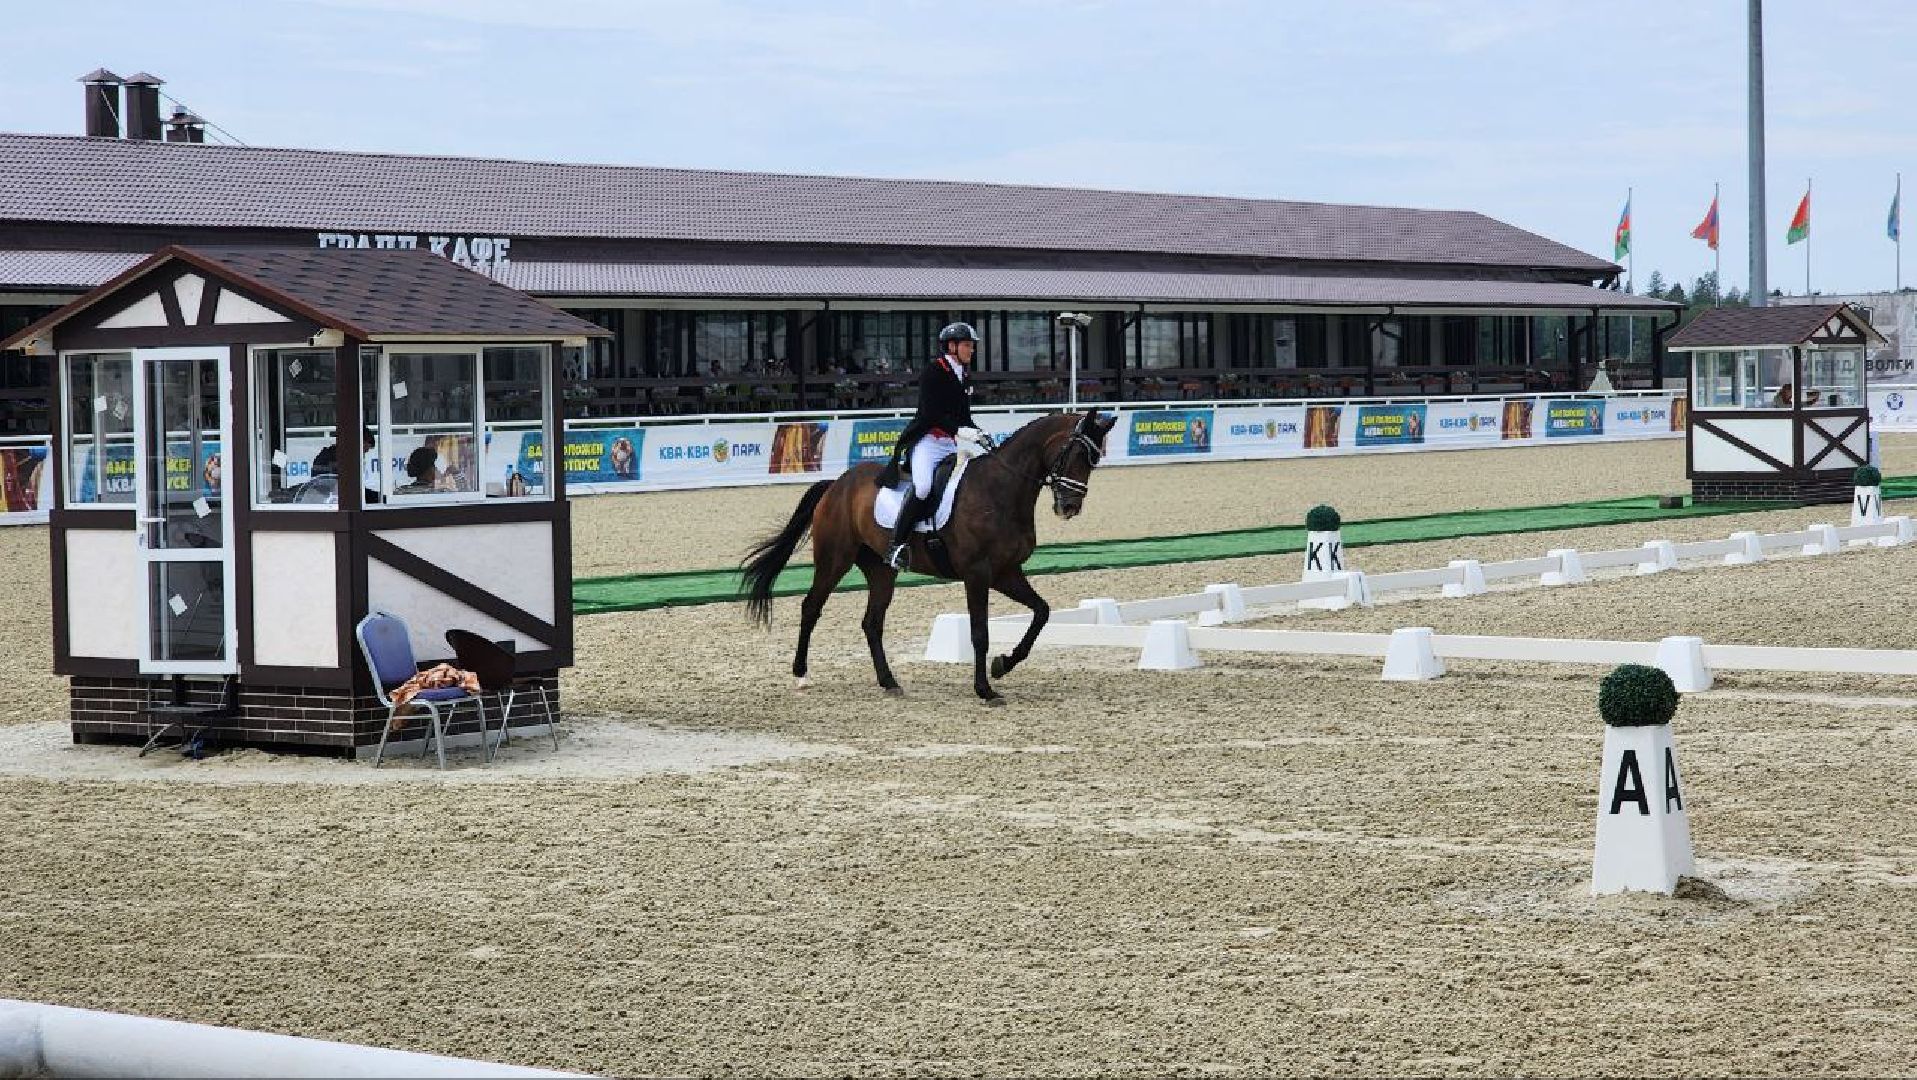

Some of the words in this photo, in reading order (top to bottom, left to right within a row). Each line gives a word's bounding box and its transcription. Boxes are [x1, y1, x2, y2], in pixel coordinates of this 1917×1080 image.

[429, 236, 511, 265] КАФЕ
[732, 443, 761, 457] ПАРК
[1857, 494, 1871, 516] V
[1308, 542, 1323, 570] K
[1329, 542, 1342, 570] K
[1609, 749, 1650, 815] A
[1665, 747, 1683, 814] A
